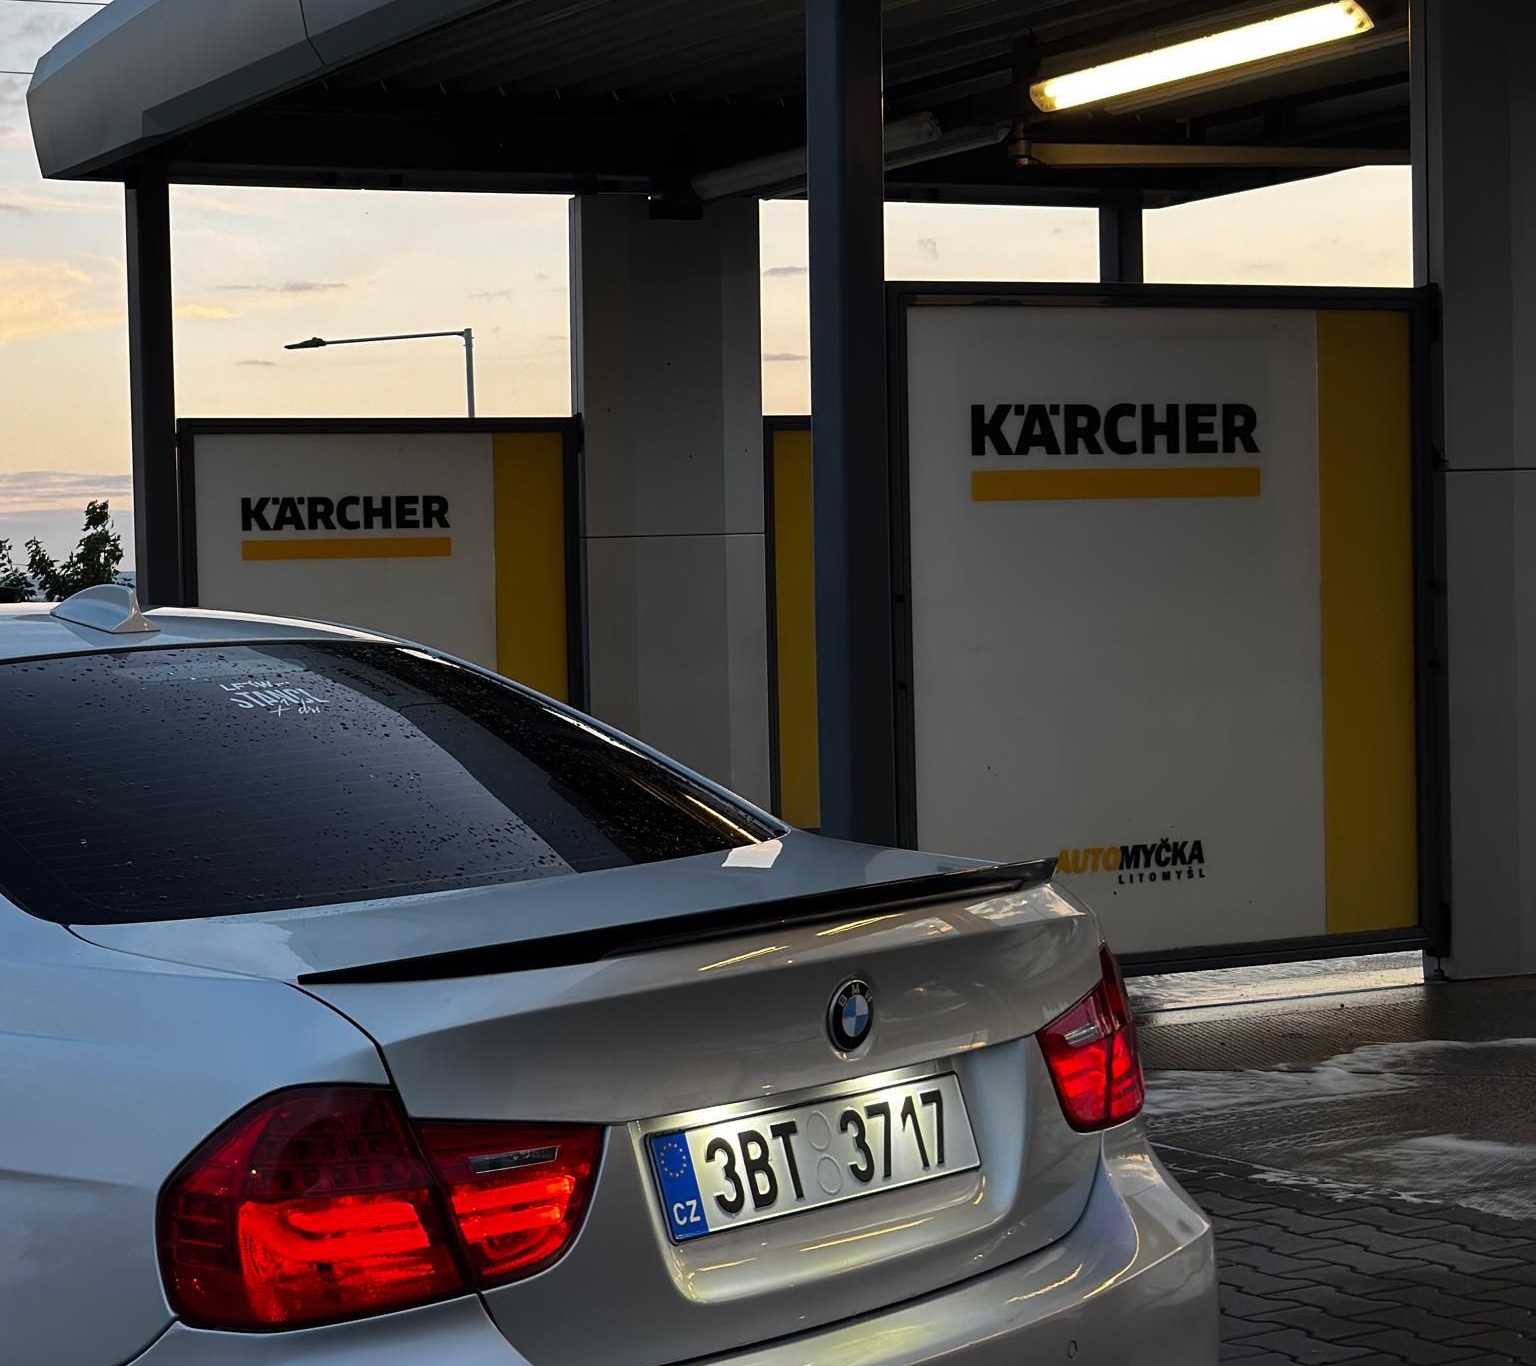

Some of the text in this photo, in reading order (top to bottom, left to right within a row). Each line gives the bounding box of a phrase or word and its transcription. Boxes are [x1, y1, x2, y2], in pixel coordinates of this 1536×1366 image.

[970, 402, 1261, 456] KÄRCHER
[241, 495, 451, 532] KÄRCHER
[1056, 837, 1205, 875] AUTOMYČKA
[1118, 867, 1206, 885] LITOMYŠL
[704, 1089, 946, 1215] 3BT 3717
[672, 1199, 702, 1226] CZ
